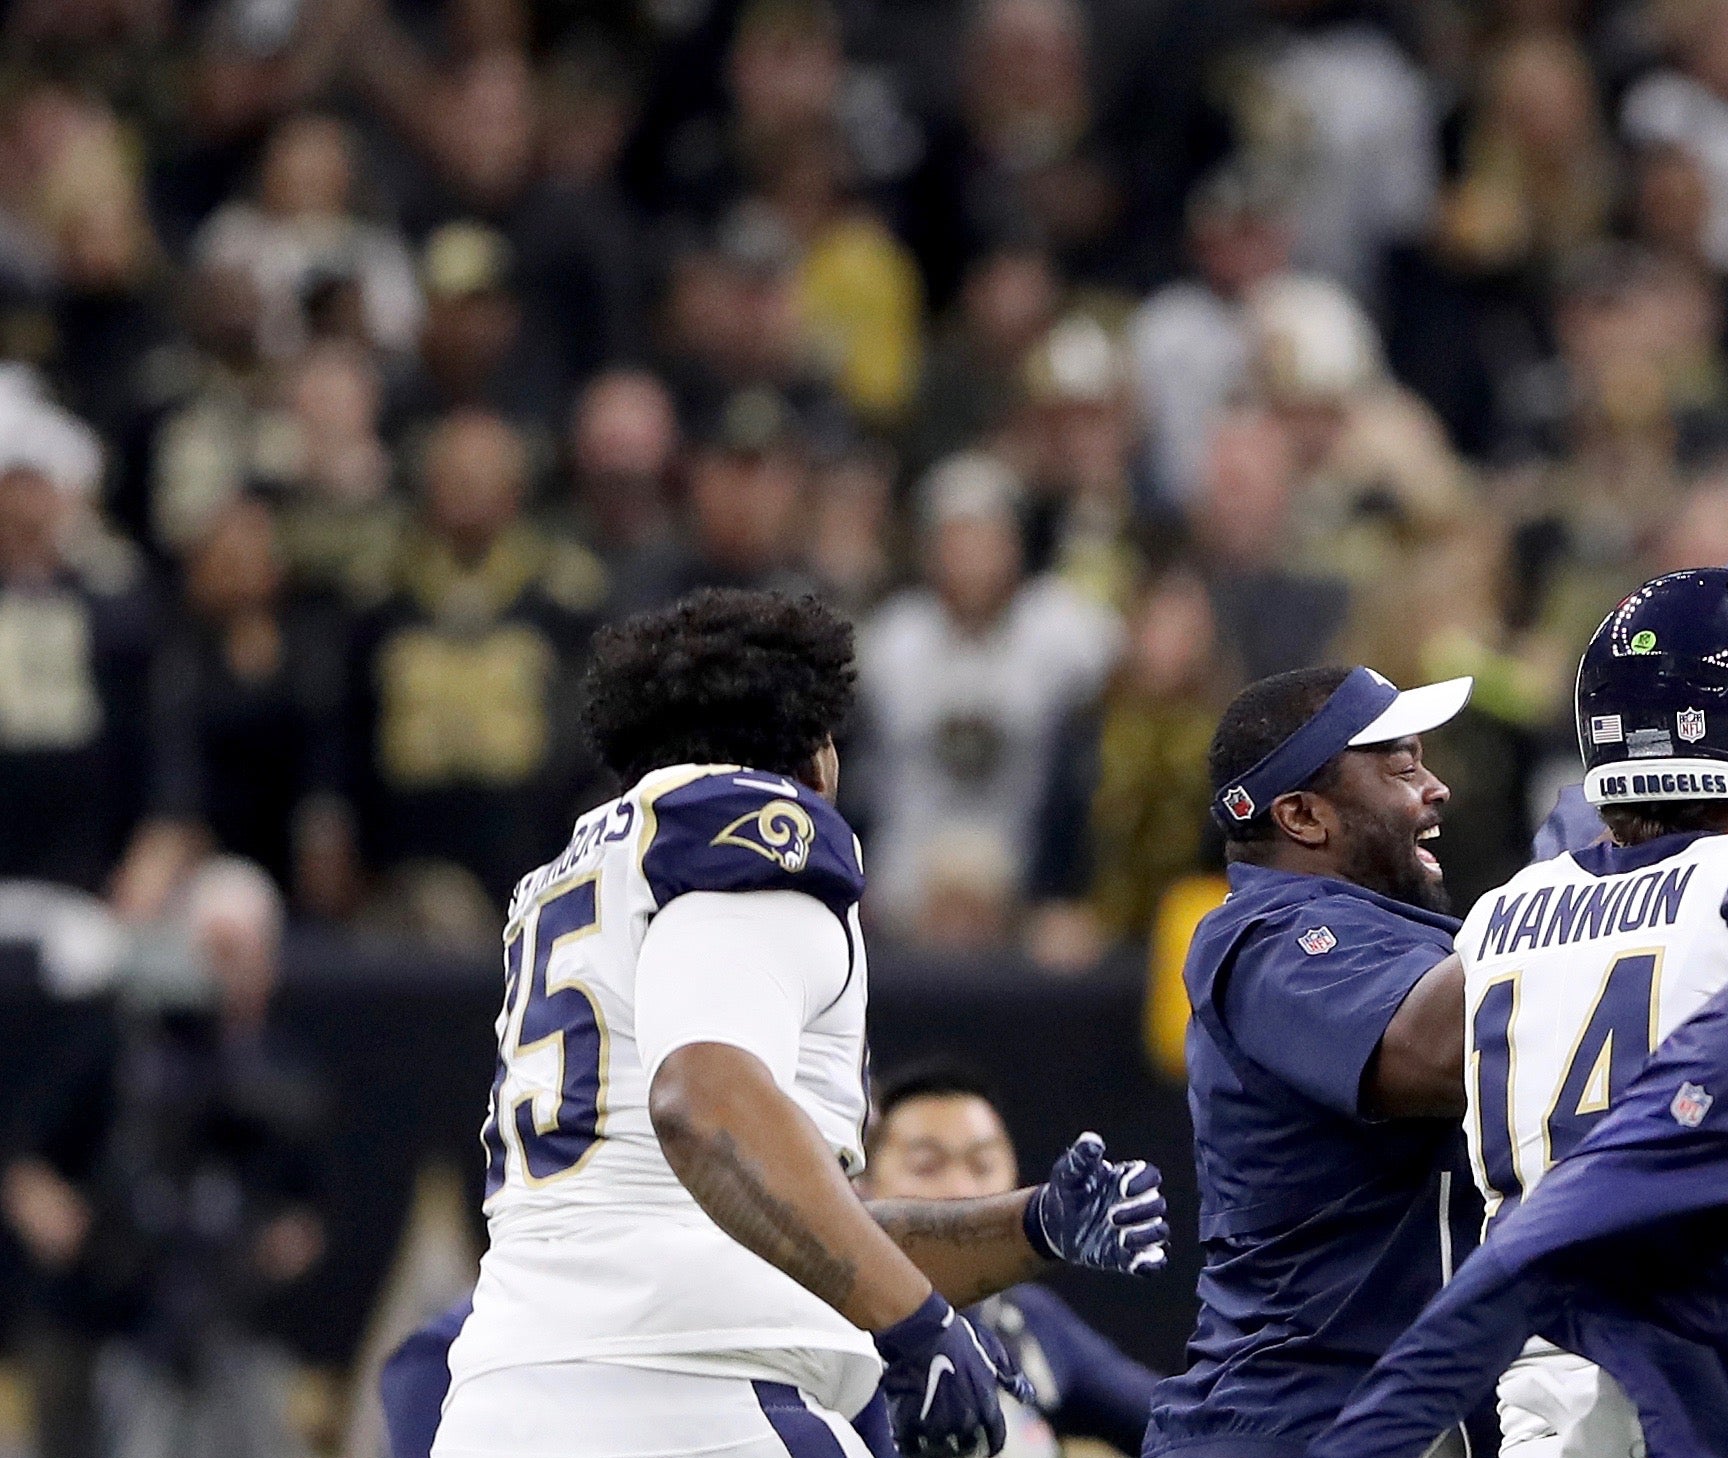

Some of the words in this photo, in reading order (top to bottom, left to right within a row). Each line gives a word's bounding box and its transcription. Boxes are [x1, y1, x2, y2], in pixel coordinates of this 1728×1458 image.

[1600, 775, 1627, 797] LOS
[1632, 773, 1727, 796] ANGELES
[1476, 863, 1700, 962] MANNION
[1468, 946, 1664, 1240] 14
